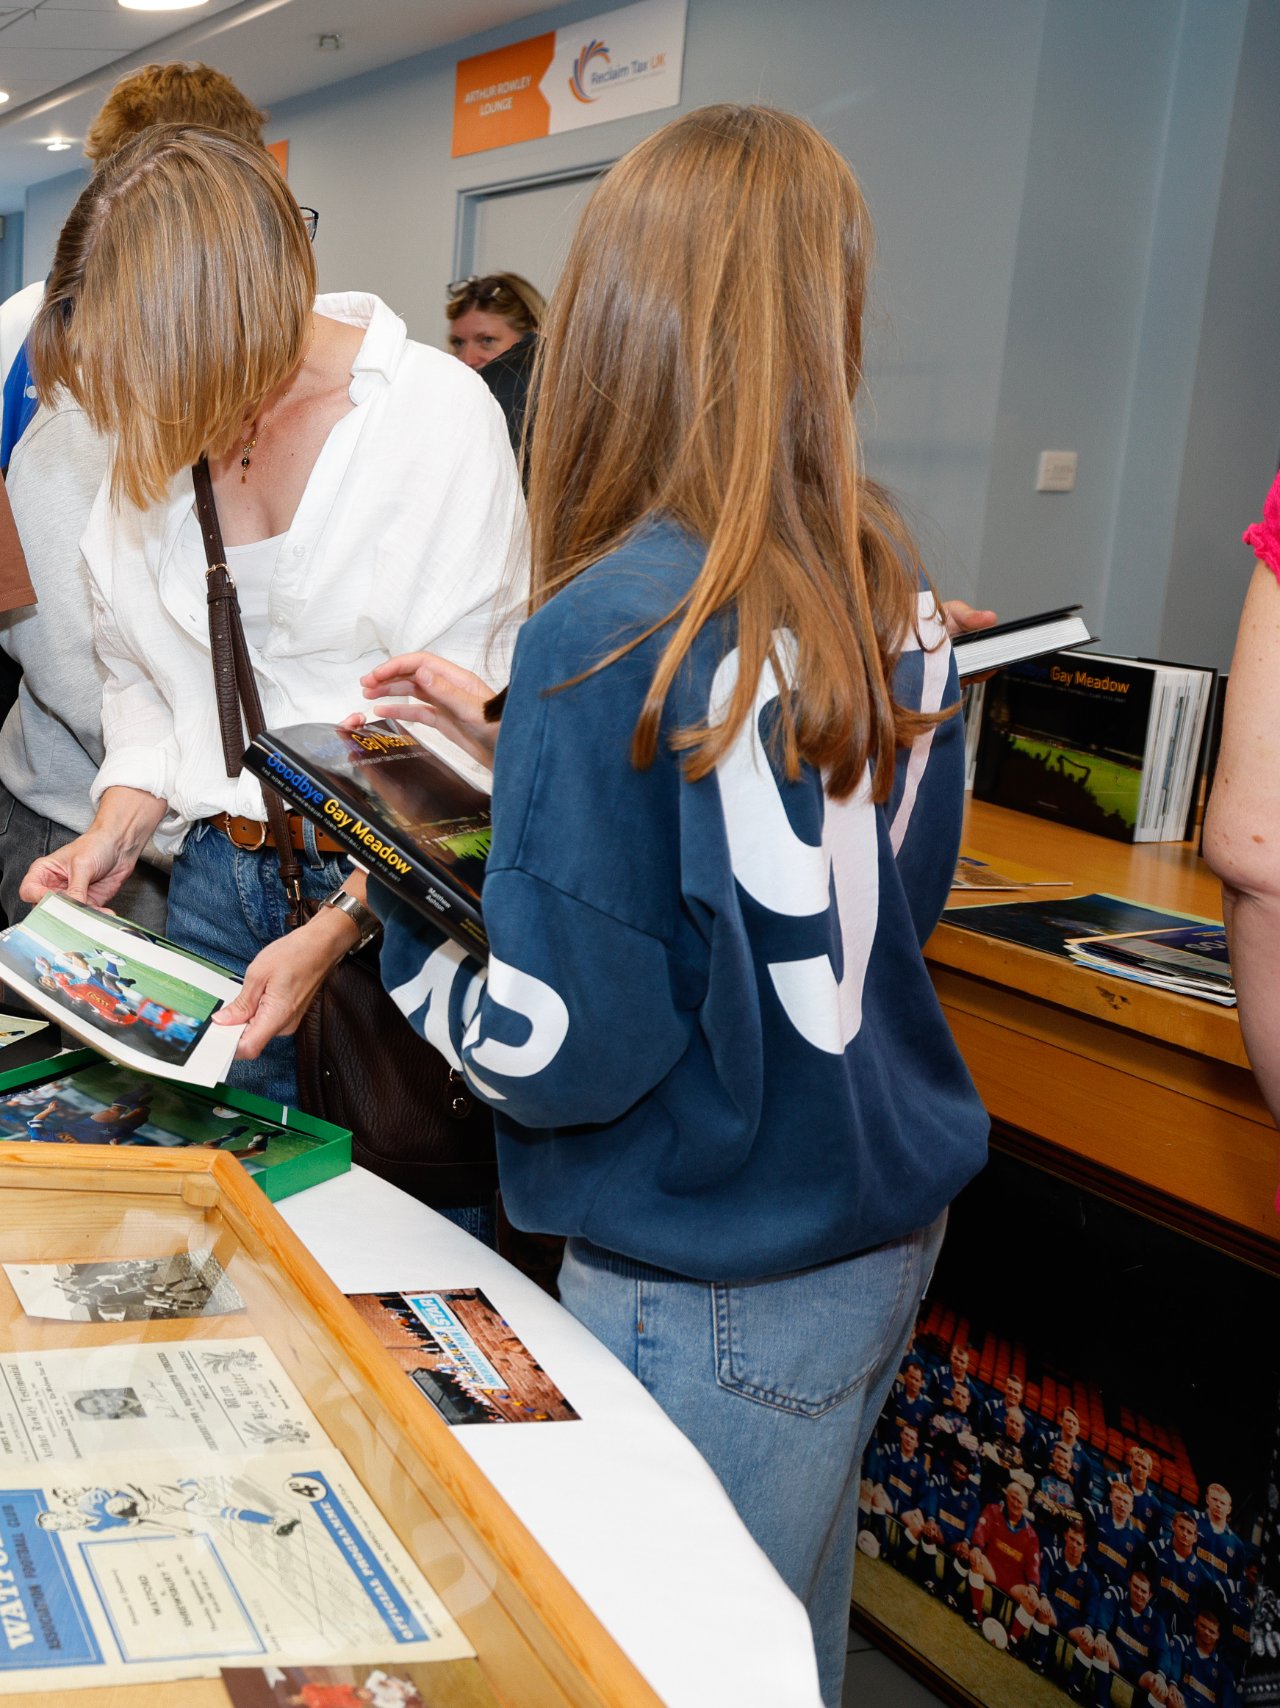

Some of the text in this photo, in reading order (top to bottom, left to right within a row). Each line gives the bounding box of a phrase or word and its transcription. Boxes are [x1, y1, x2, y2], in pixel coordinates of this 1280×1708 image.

[590, 65, 629, 87] Reclaim
[631, 58, 648, 76] Tax
[650, 52, 667, 69] UK
[464, 75, 532, 104] ARTHUR ROWLEY
[480, 97, 513, 117] LOUNGE
[1050, 665, 1074, 688] Gay
[1074, 670, 1130, 695] Meadow
[351, 733, 388, 754] Gay
[266, 751, 412, 876] Goodbye Gay Meadow
[418, 1298, 449, 1326] STAR
[6, 1364, 32, 1402] Testimonial
[22, 1405, 45, 1431] Rowley
[34, 1433, 55, 1458] Arthur
[317, 1500, 375, 1577] PROGRAMME
[1, 1503, 62, 1652] ASSOCIATION FOOTBALL CLUB
[136, 1574, 163, 1616] WATFORD
[160, 1572, 195, 1627] SHREWSBURY
[362, 1576, 415, 1640] OFFICIAL
